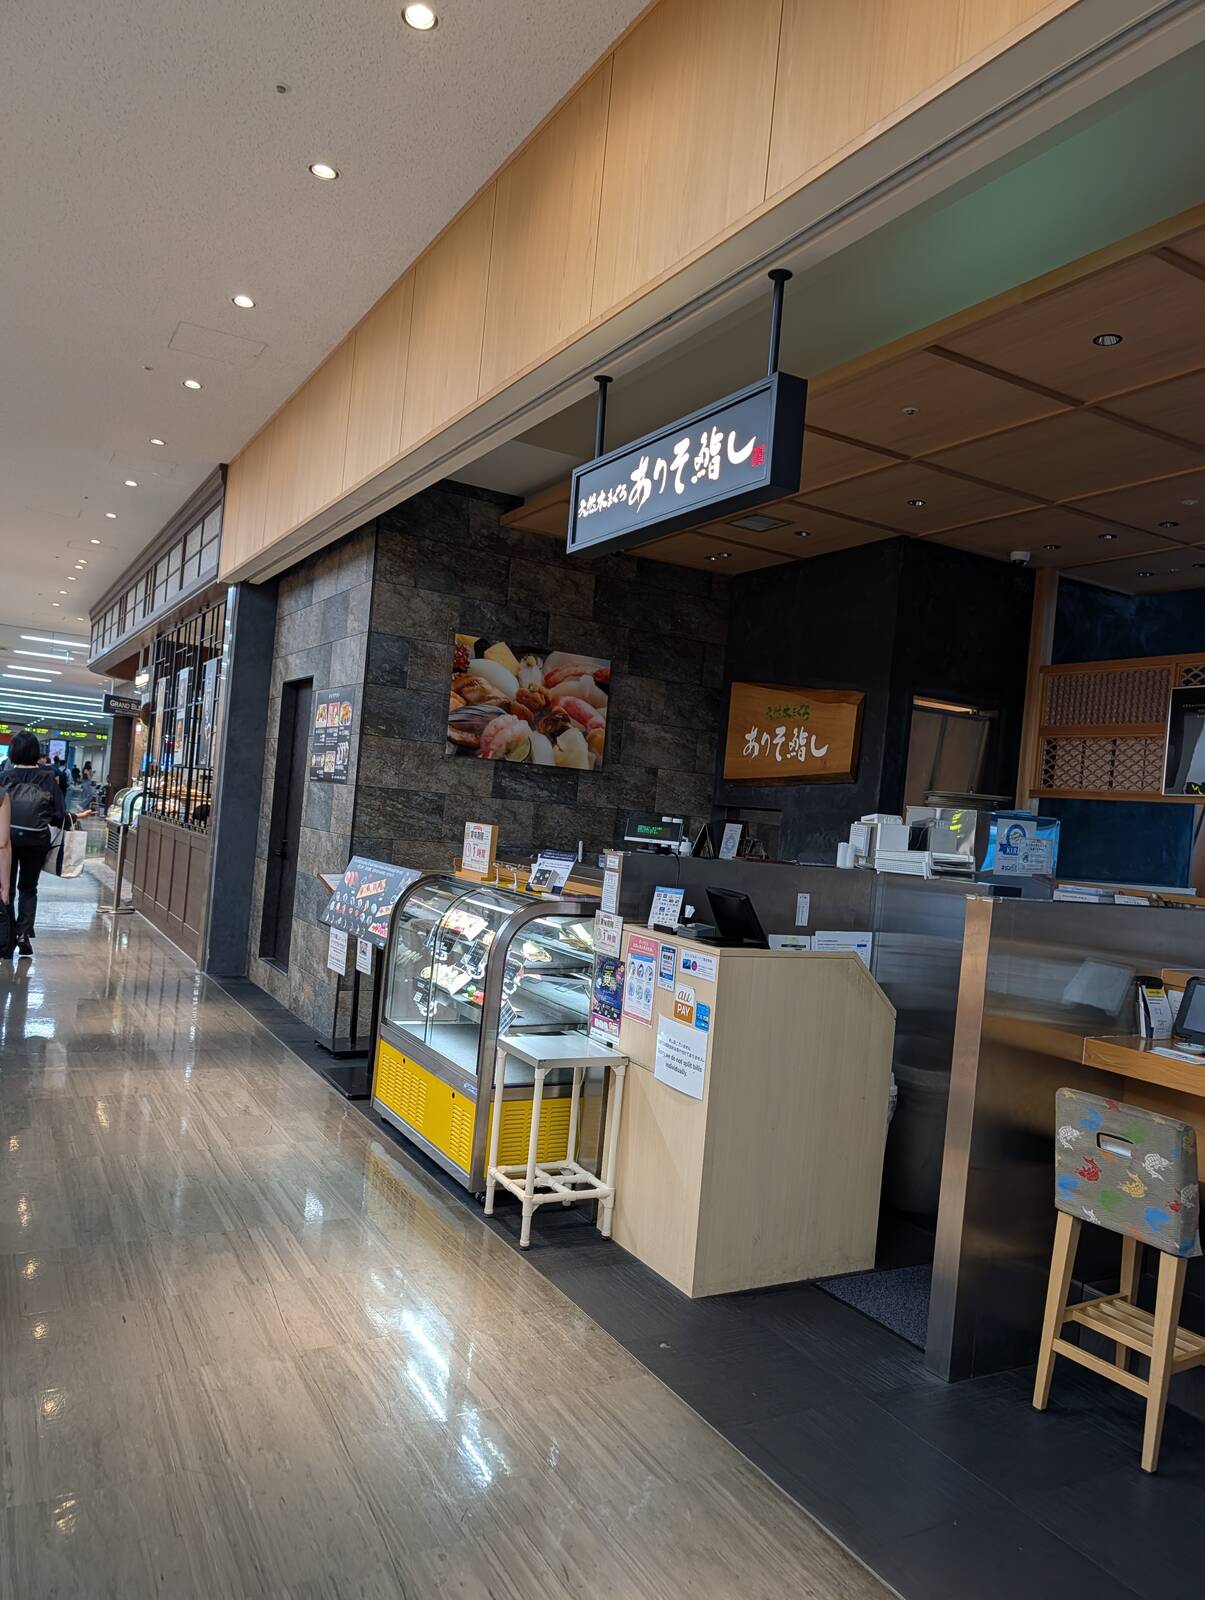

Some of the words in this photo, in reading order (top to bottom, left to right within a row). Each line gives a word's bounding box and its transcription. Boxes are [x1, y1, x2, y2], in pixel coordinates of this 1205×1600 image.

[627, 426, 757, 512] ありそ鮨し
[110, 699, 130, 709] GRAND
[743, 725, 829, 762] ありそ鮨し
[677, 1003, 690, 1017] PAY
